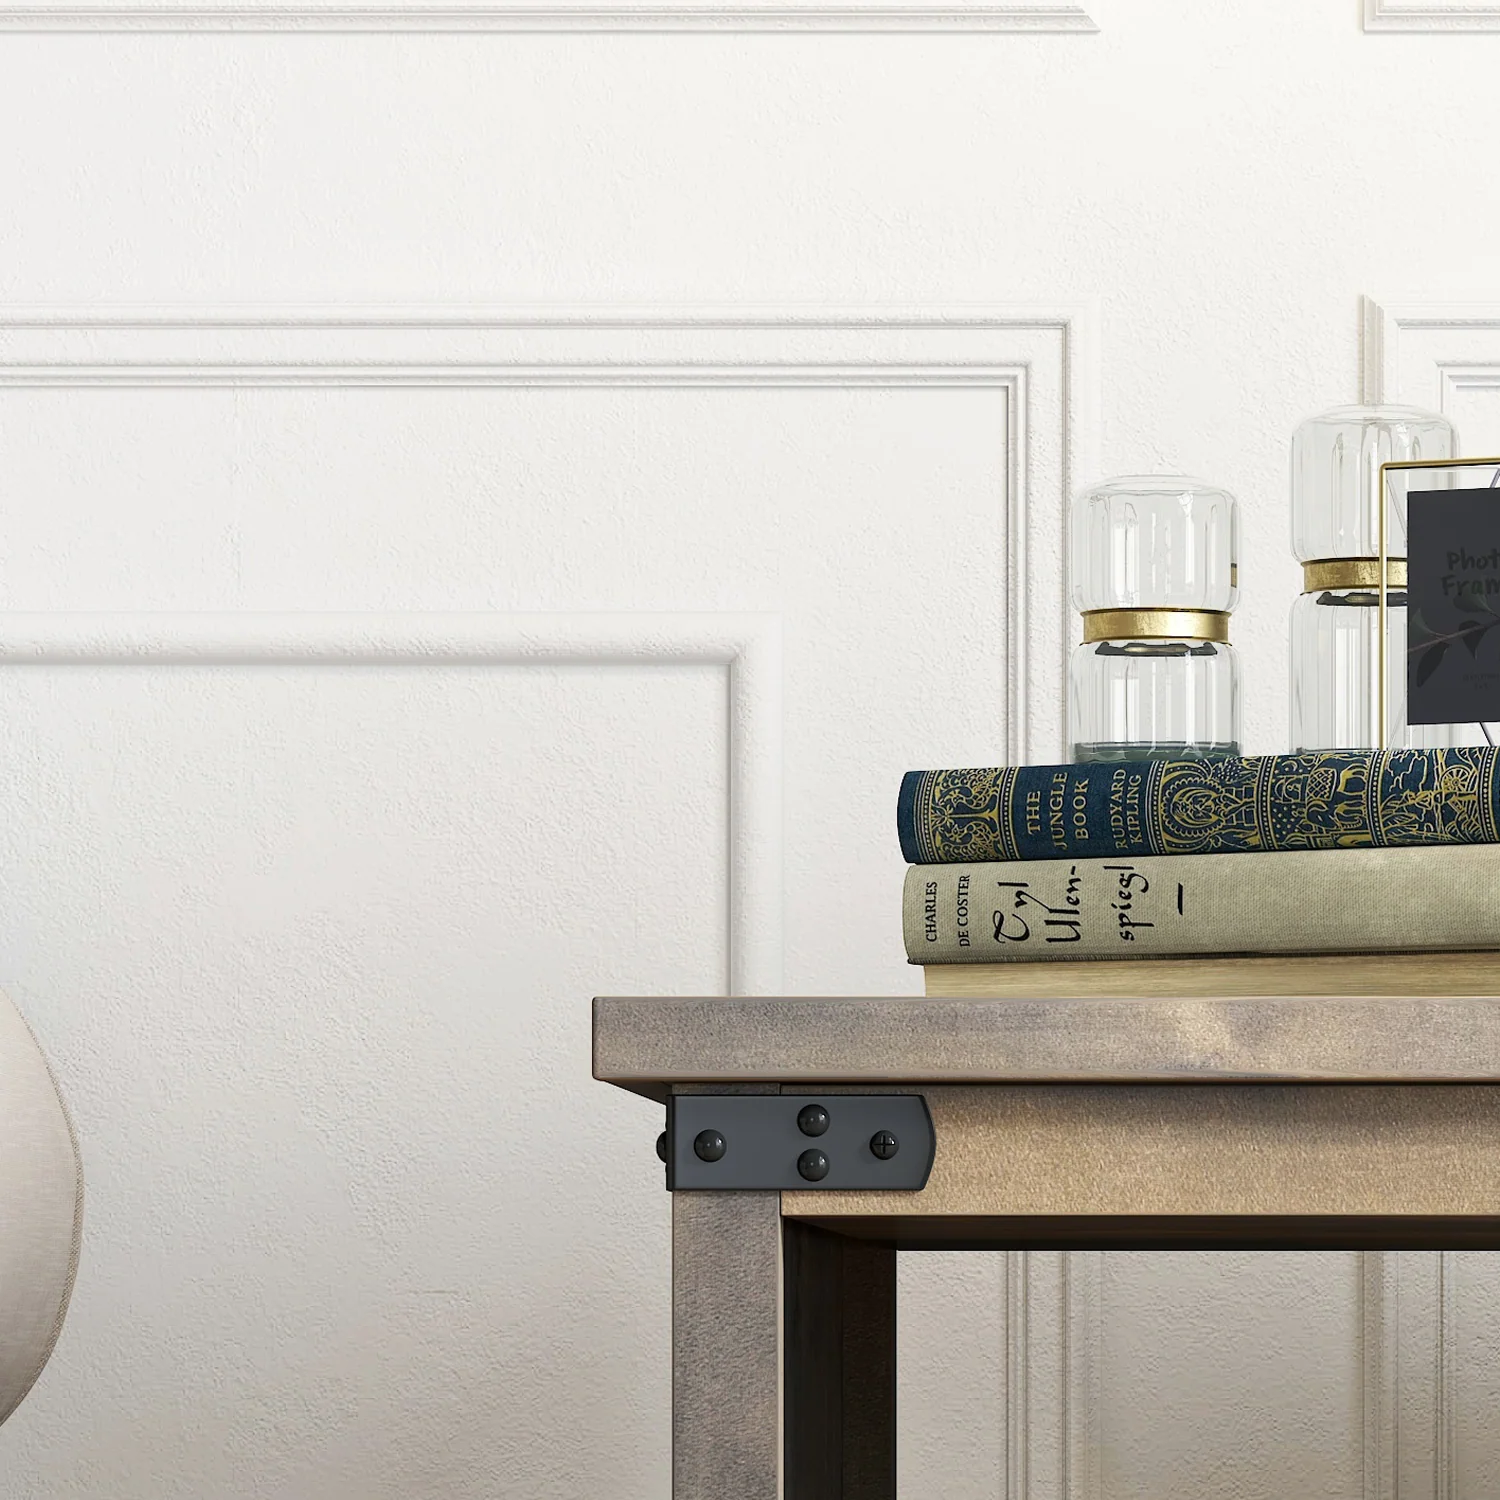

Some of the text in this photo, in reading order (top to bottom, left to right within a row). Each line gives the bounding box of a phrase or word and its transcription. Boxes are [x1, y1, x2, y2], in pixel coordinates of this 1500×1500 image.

[1026, 790, 1041, 835] THE
[1049, 772, 1068, 850] JUNGLE
[1072, 778, 1090, 840] BOOK
[1110, 768, 1128, 849] RUDYARD
[1127, 774, 1143, 844] KIPLING
[925, 881, 938, 943] CHARLES
[956, 874, 971, 947] DE COSTER
[1103, 865, 1155, 941] spiegl
